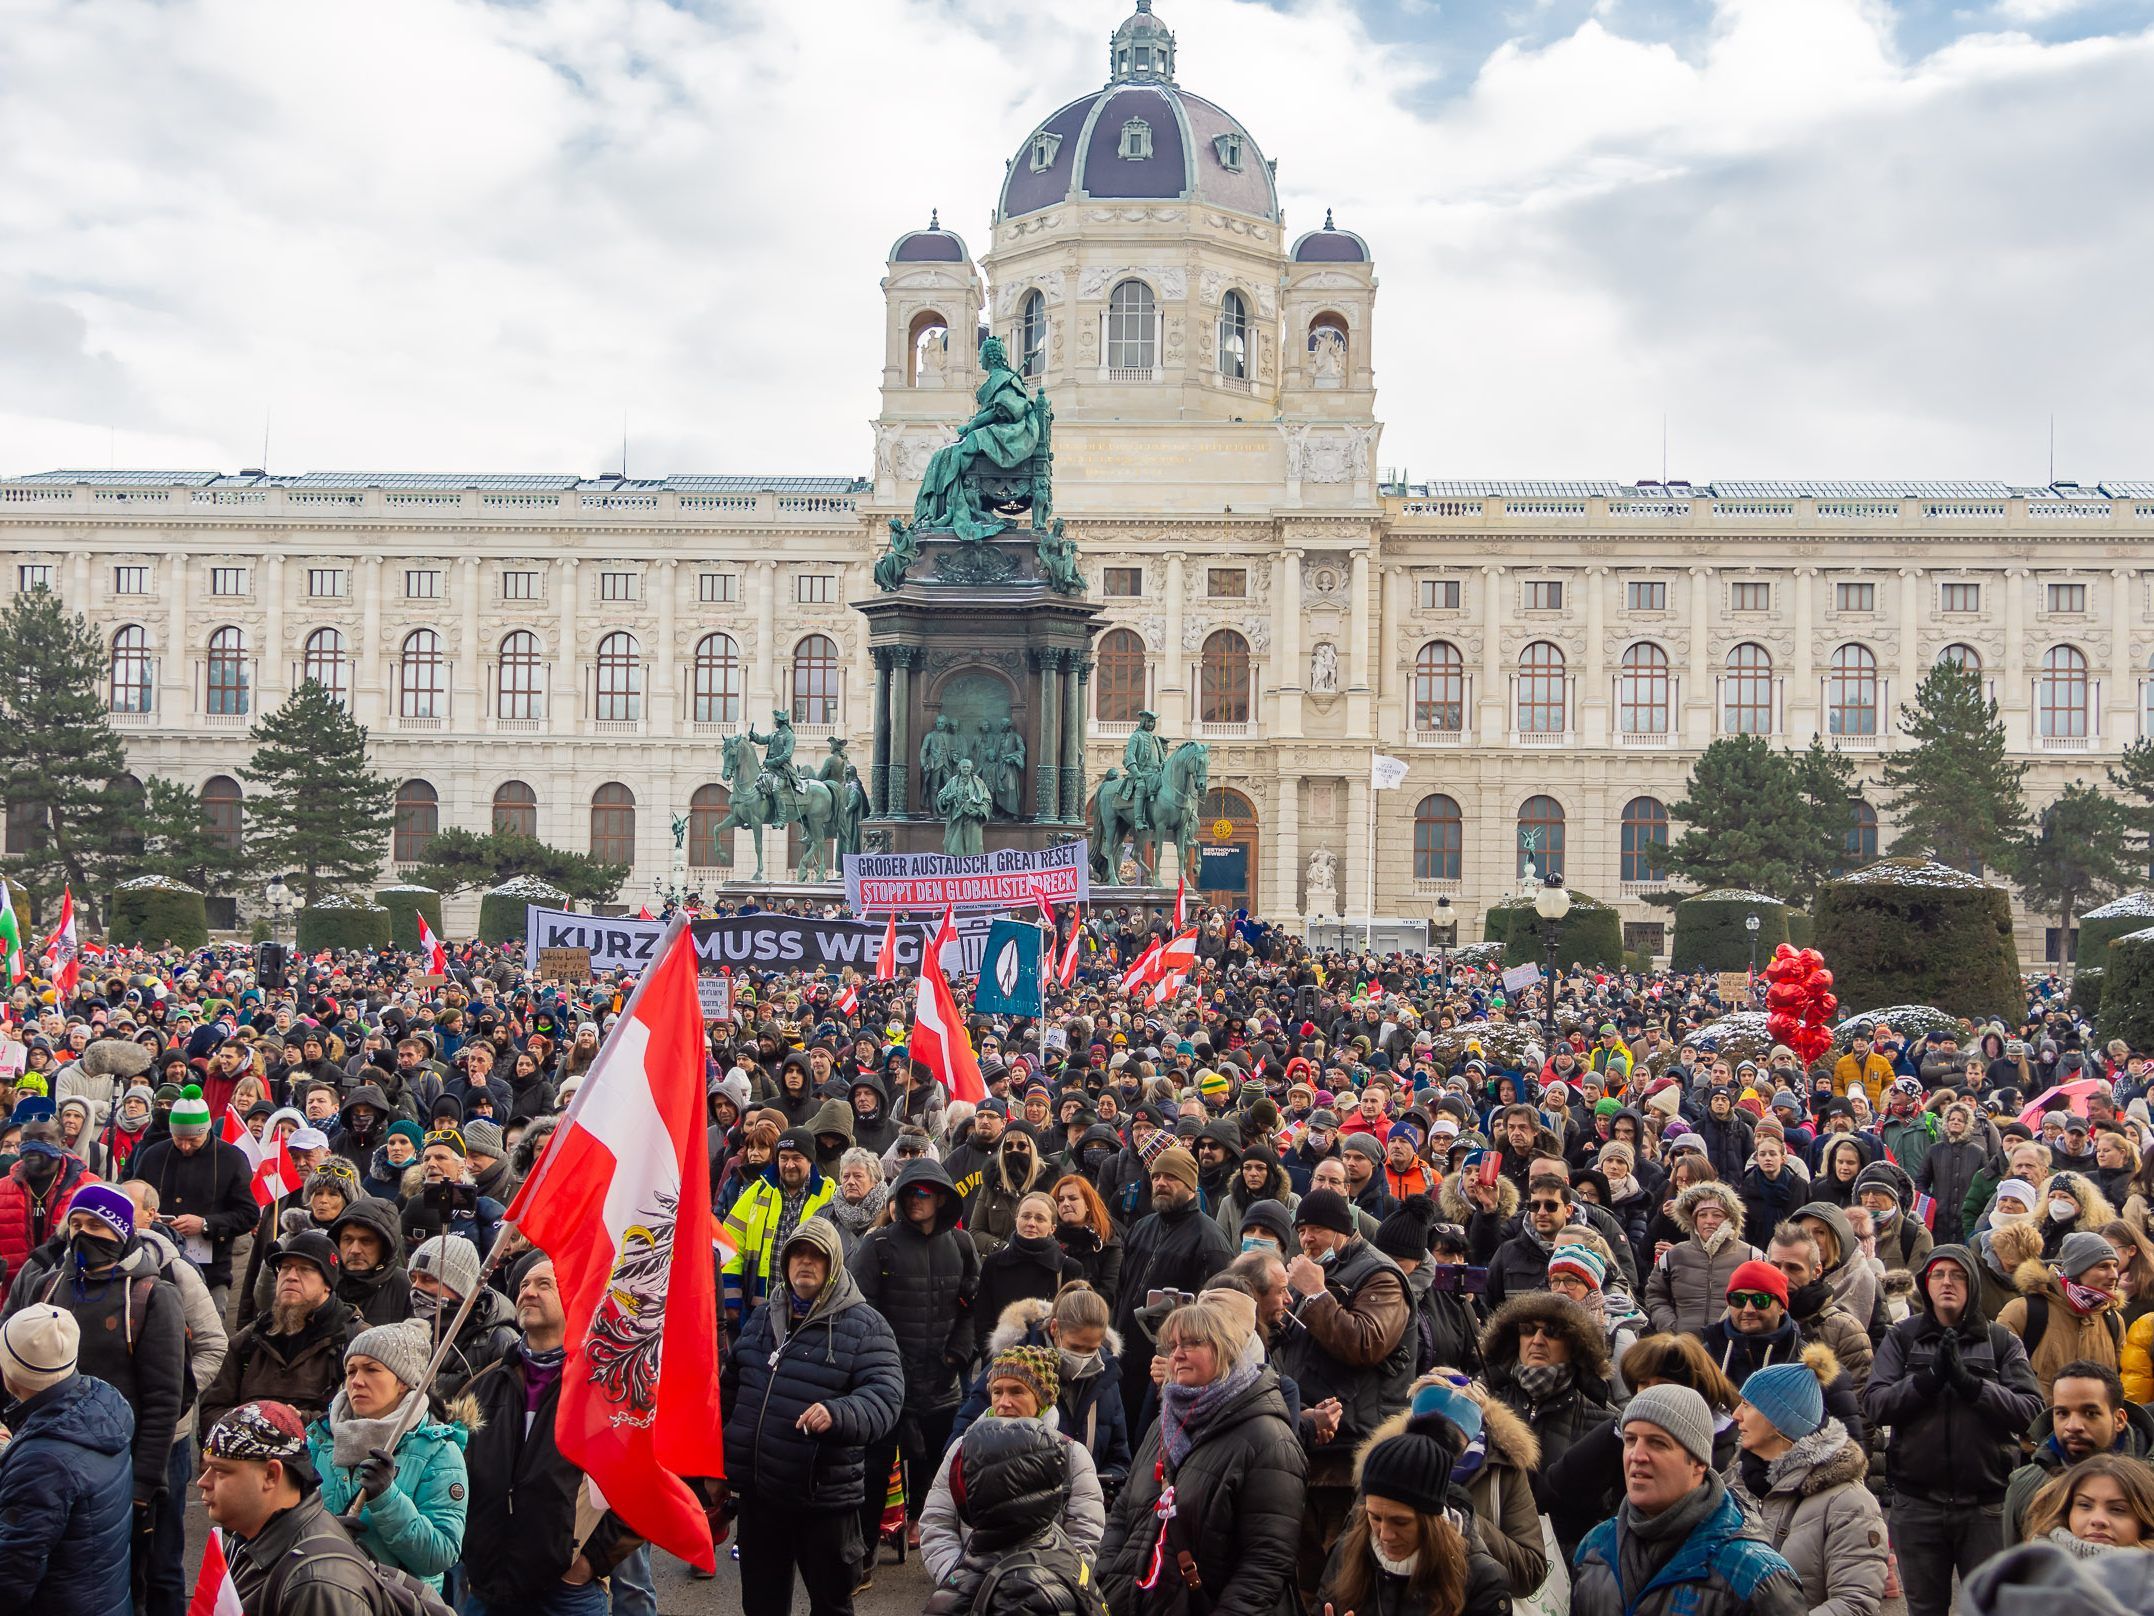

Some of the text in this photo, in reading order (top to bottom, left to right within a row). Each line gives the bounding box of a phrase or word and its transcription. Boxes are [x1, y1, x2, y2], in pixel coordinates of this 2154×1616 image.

[911, 854, 993, 876] AUSTAUSCH,
[997, 851, 1036, 872] GREAT
[1041, 845, 1077, 869] RESET
[863, 882, 913, 902] STOPPT
[915, 881, 943, 901] DEN
[548, 924, 920, 964] KURZ MUSS WEG
[96, 1204, 131, 1232] 1933
